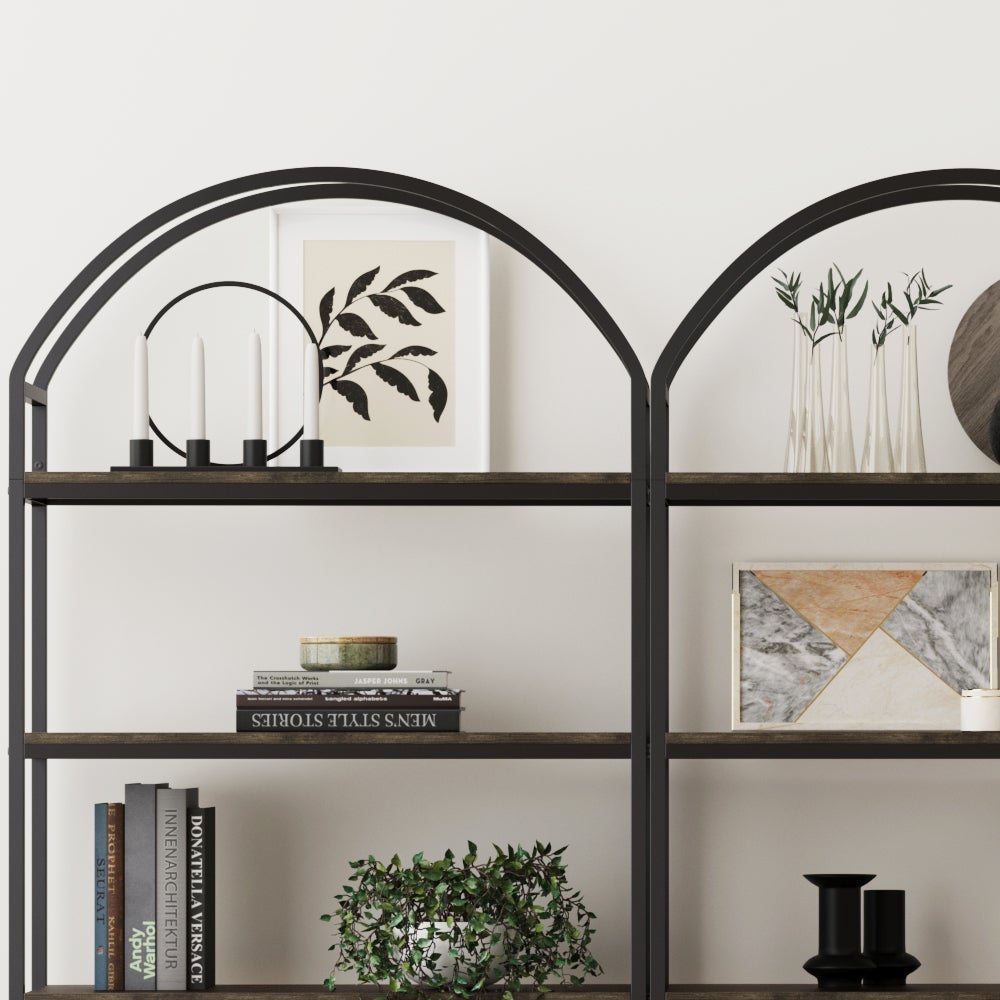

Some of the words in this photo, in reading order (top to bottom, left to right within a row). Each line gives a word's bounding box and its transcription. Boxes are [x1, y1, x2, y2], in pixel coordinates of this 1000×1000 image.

[252, 713, 324, 727] STORIES
[328, 713, 380, 727] STYLE
[384, 713, 437, 727] MEN'S
[96, 858, 106, 925] SEURAT
[164, 809, 178, 969] INNENARCHITEKTUR
[191, 815, 202, 908] DONATELLA
[128, 928, 145, 972] Andy
[142, 920, 155, 980] Warhol
[191, 912, 202, 984] VERSACE
